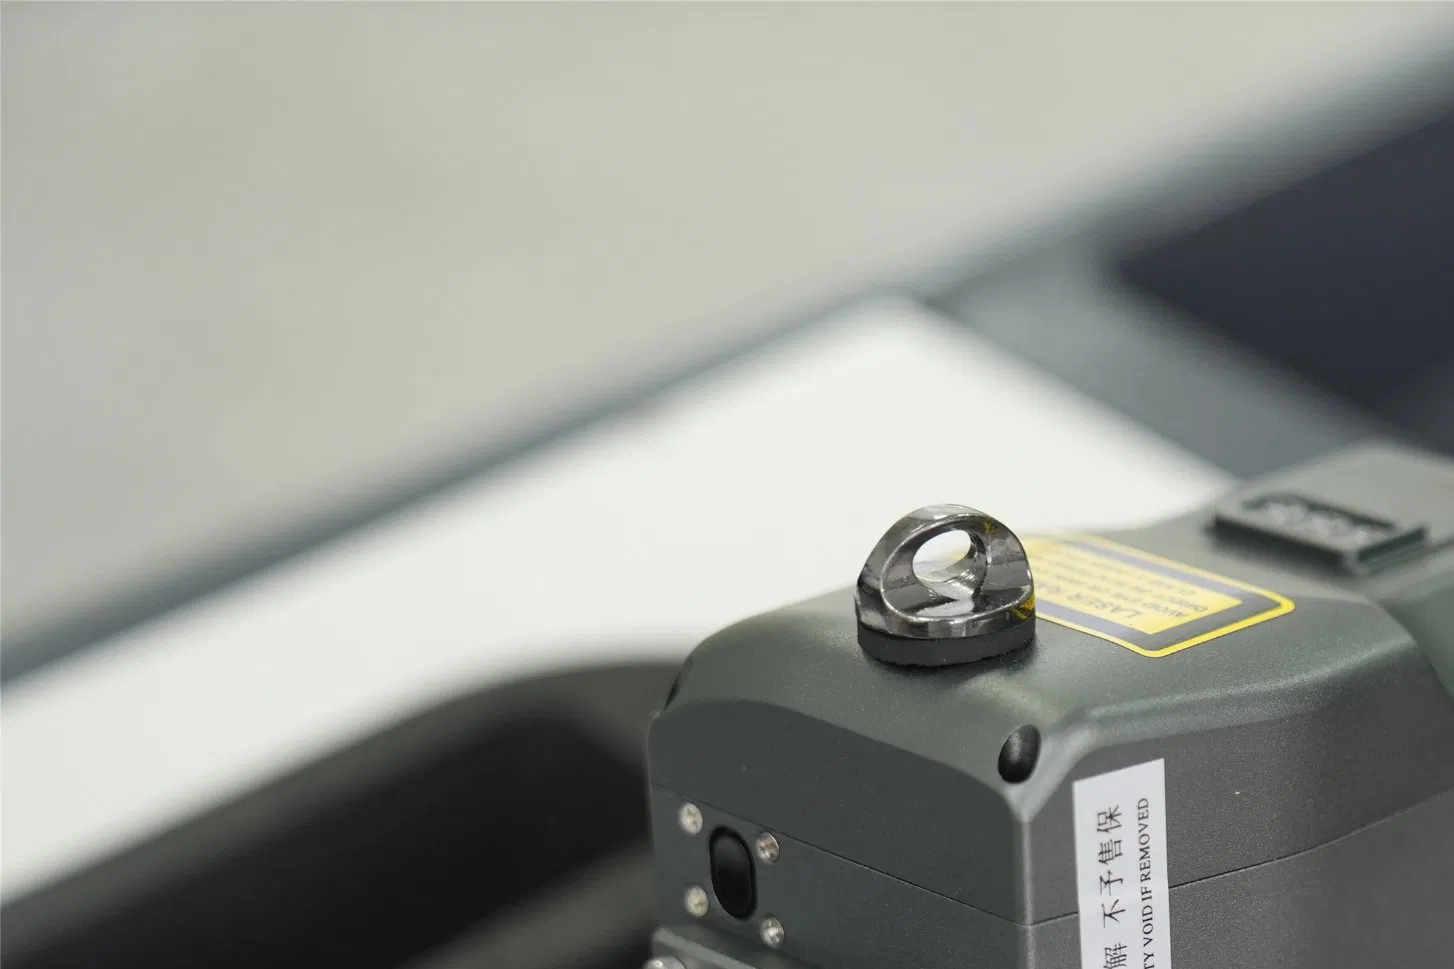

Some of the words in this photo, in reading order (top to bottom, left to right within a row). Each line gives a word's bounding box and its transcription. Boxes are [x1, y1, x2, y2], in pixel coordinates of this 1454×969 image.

[1096, 803, 1126, 928] 不予售保
[1137, 798, 1152, 882] REMOVED
[1140, 886, 1153, 902] IF
[1141, 904, 1154, 947] VOID
